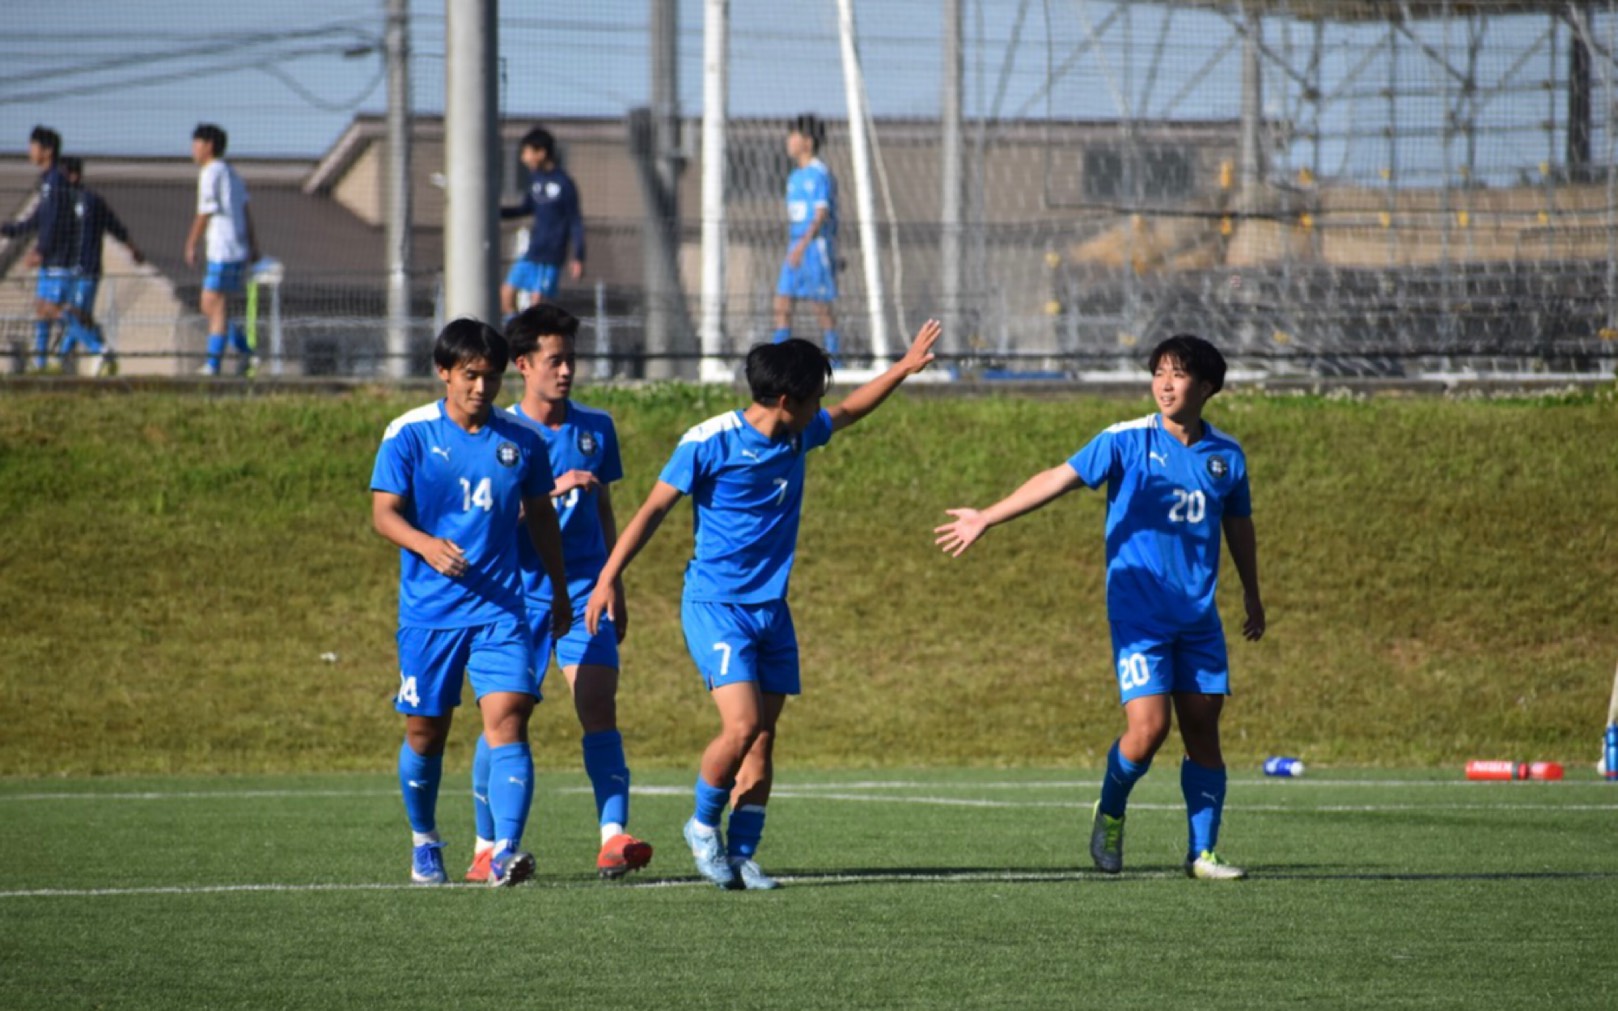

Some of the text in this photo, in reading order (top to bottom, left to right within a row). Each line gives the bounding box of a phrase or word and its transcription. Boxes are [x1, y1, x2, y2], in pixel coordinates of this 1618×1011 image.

[459, 477, 494, 512] 14
[773, 477, 788, 507] 7
[1168, 489, 1206, 524] 20
[713, 642, 731, 676] 7
[1119, 652, 1150, 691] 20
